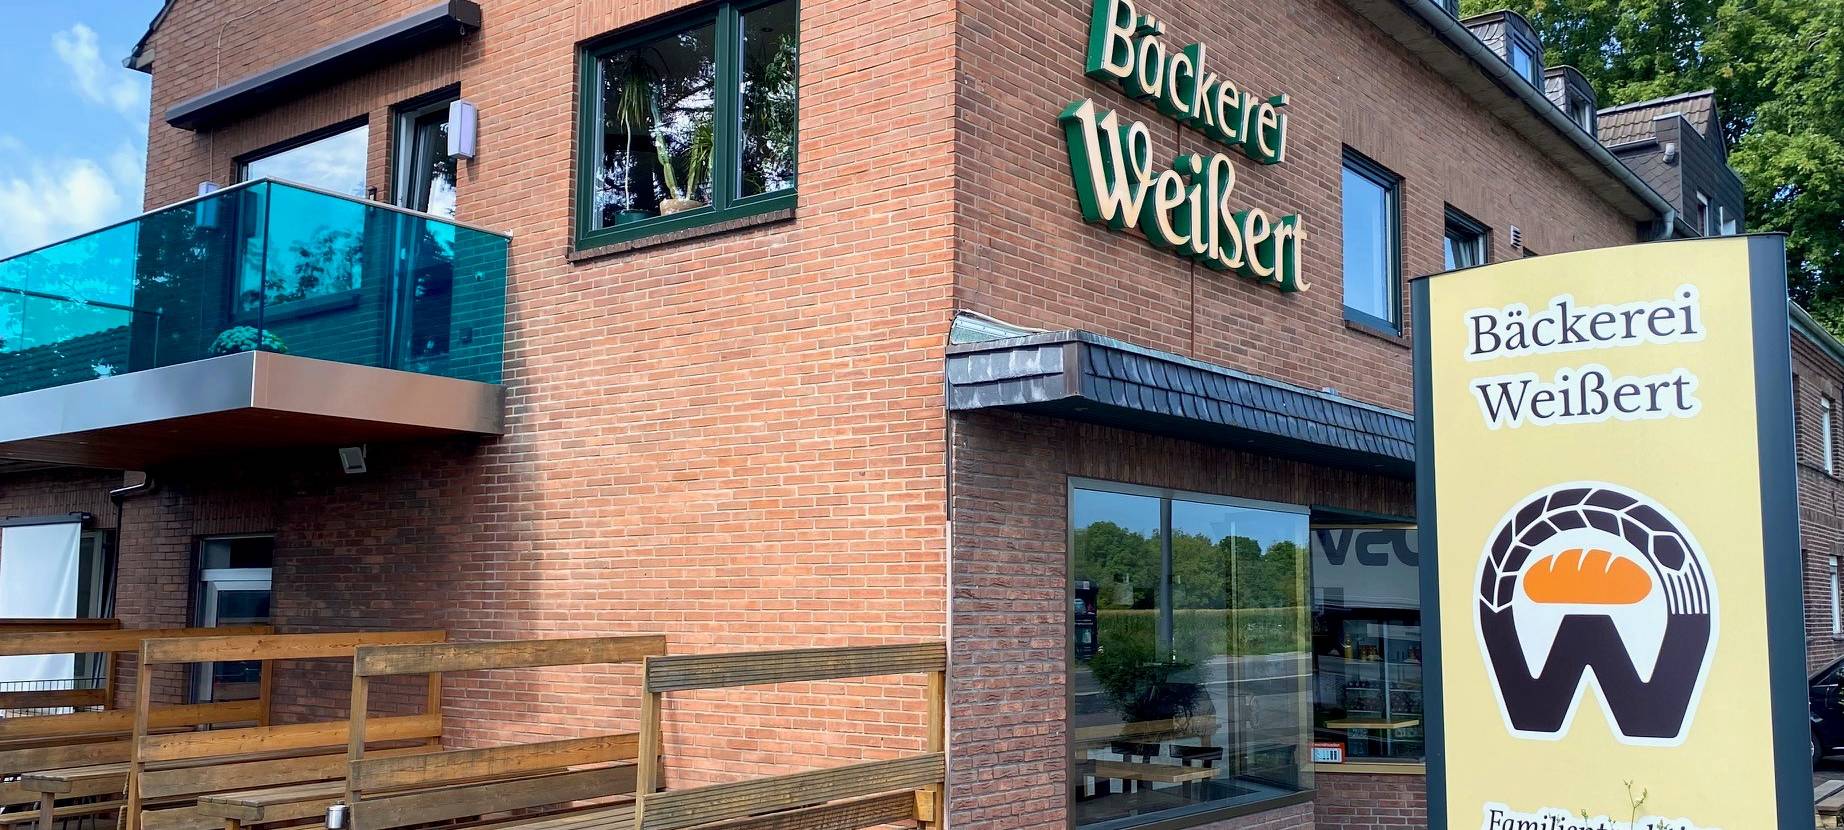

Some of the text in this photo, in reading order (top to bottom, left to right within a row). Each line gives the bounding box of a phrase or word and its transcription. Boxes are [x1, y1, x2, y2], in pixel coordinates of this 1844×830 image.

[1099, 0, 1289, 163] Bäckerei
[1074, 98, 1311, 292] Weißert
[1469, 291, 1699, 355] Bäckerei
[1476, 371, 1694, 424] Weißert
